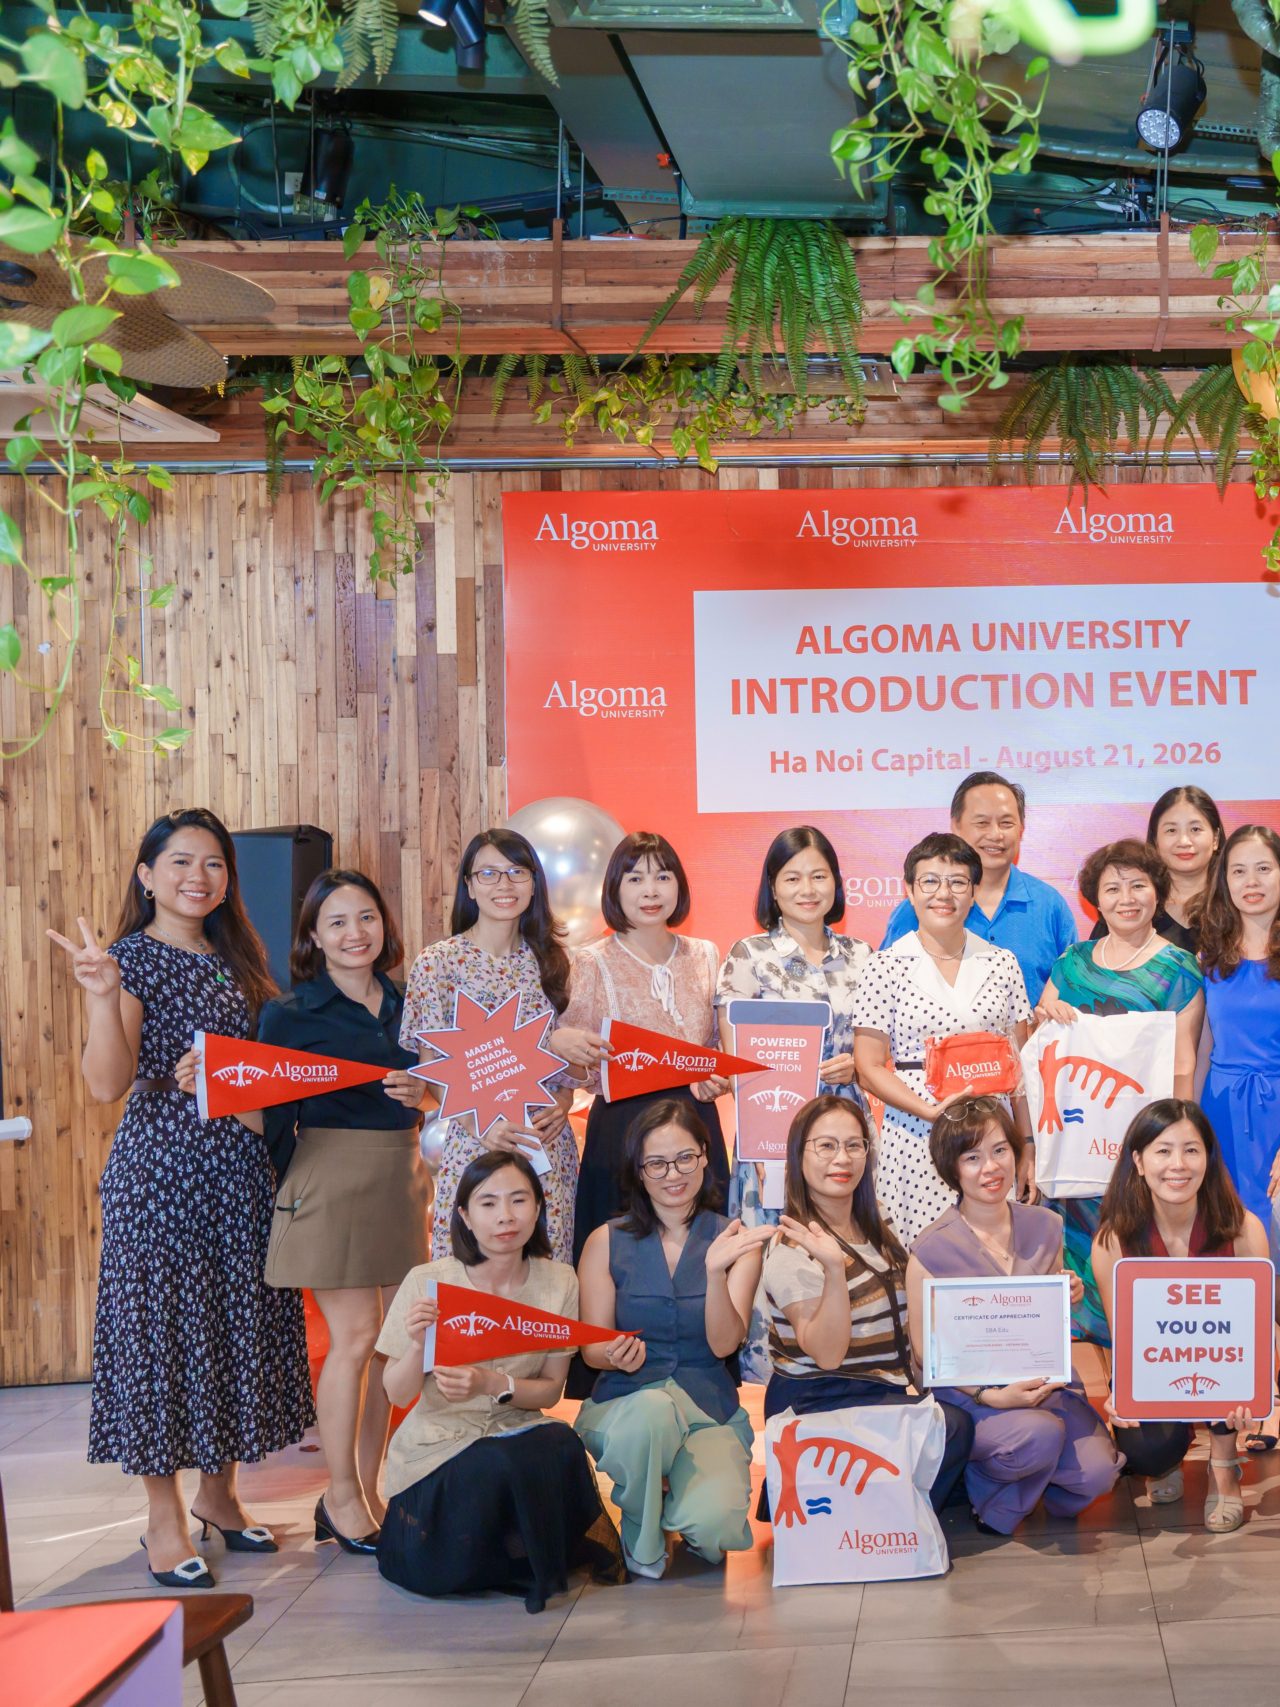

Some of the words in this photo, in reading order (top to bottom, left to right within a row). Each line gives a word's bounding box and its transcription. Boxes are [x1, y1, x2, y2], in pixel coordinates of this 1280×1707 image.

[534, 513, 660, 551] Algoma
[796, 510, 918, 547] Algoma
[1054, 506, 1174, 543] Algoma
[592, 542, 657, 552] UNIVERSITY
[853, 539, 917, 549] UNIVERSITY
[1110, 535, 1173, 544] UNIVERSITY
[796, 623, 962, 655] ALGOMA
[972, 619, 1191, 652] UNIVERSITY
[543, 679, 667, 717] Algoma
[731, 672, 1095, 716] INTRODUCTION
[1109, 669, 1257, 708] EVENT
[601, 709, 665, 719] UNIVERSITY
[770, 750, 807, 774] Ha
[815, 748, 863, 773] Noi
[871, 746, 971, 777] Capital
[996, 745, 1096, 774] August
[1103, 743, 1144, 769] 21,
[1152, 742, 1222, 765] 2026
[464, 1041, 493, 1059] MADE
[493, 1036, 505, 1047] IN
[750, 1037, 807, 1048] POWERED
[466, 1047, 512, 1070] CANADA,
[660, 1050, 717, 1071] Algoma
[756, 1050, 800, 1061] COFFEE
[271, 1061, 338, 1082] Algoma
[469, 1055, 518, 1080] STUDYING
[471, 1081, 483, 1092] AT
[485, 1063, 526, 1086] ALGOMA
[945, 1060, 1002, 1080] Algoma
[1088, 1137, 1122, 1161] Alg
[990, 1293, 1032, 1307] Algoma
[1166, 1283, 1222, 1305] SEE
[502, 1315, 571, 1336] Algoma
[1156, 1320, 1197, 1335] YOU
[1202, 1320, 1231, 1334] ON
[1143, 1346, 1244, 1363] CAMPUS!
[838, 1529, 919, 1555] Algoma
[875, 1547, 918, 1556] UNIVERSITY
